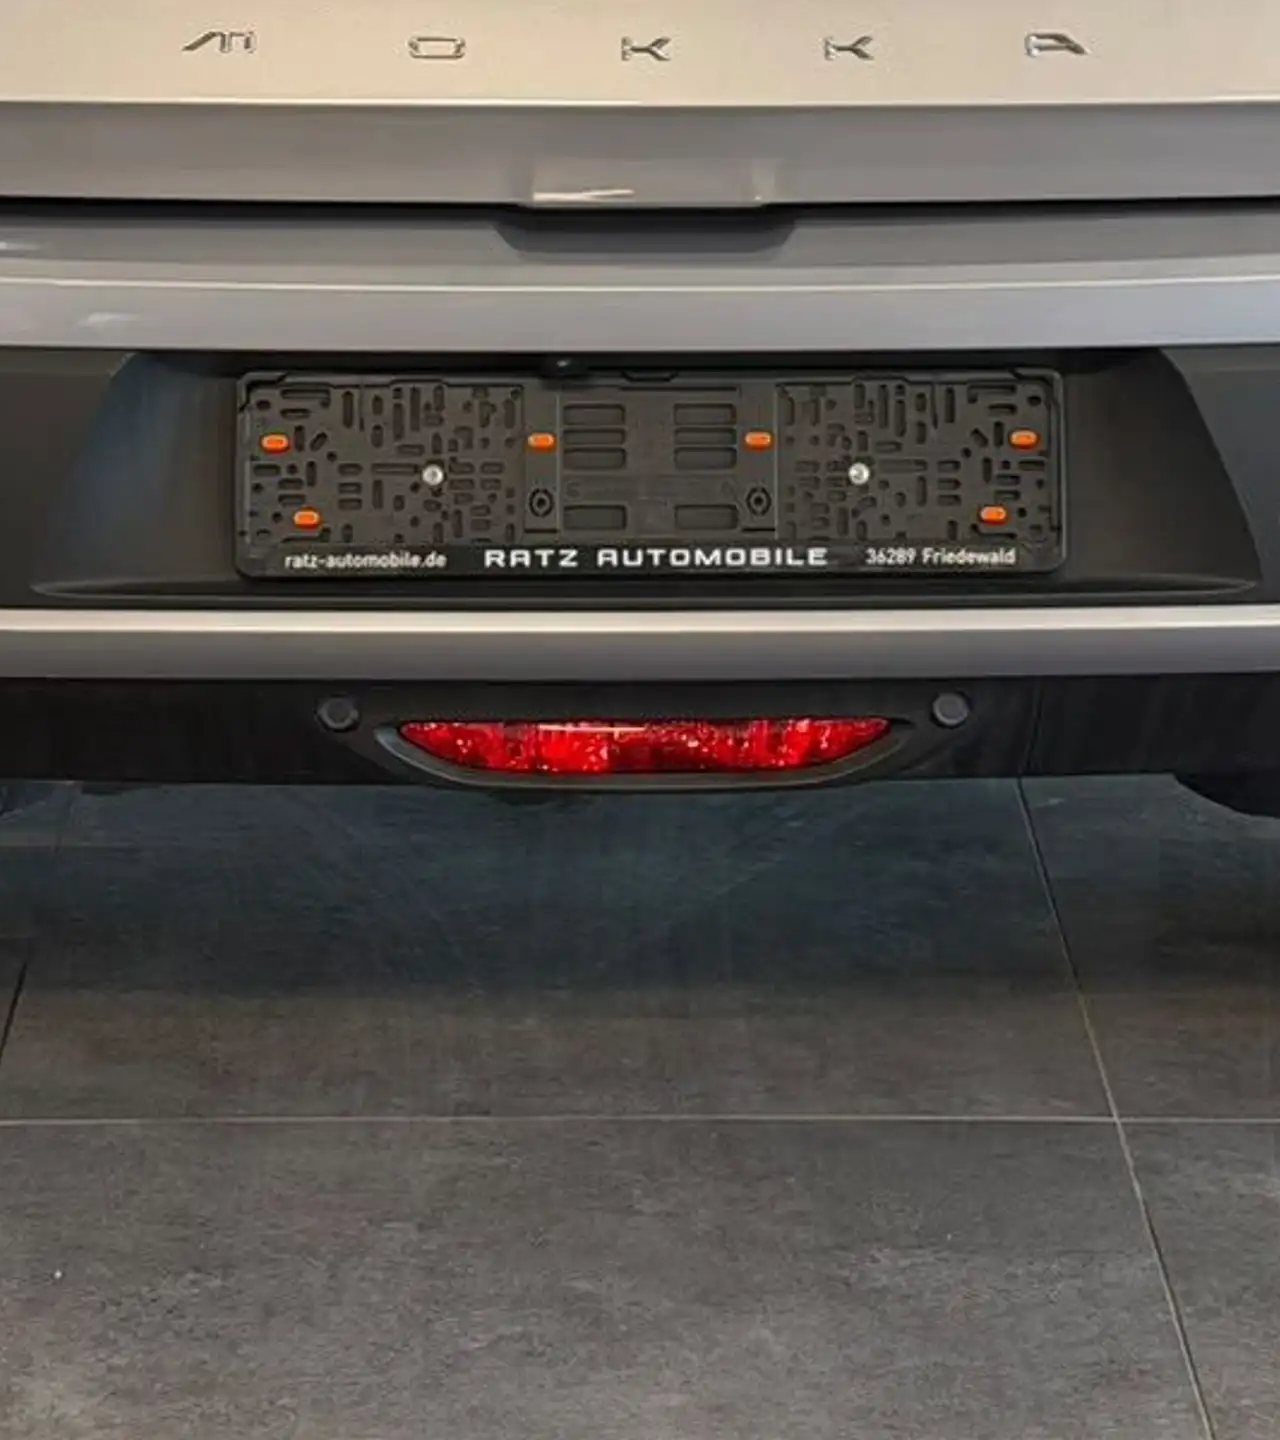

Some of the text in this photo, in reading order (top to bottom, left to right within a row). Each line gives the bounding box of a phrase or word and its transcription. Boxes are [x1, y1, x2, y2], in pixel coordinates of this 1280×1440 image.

[181, 30, 1089, 61] MOKKA
[284, 550, 448, 570] ratz-automobile.de
[483, 547, 829, 568] RATZ AUTOMOBILE
[865, 546, 1017, 566] 36289 Friedewald
